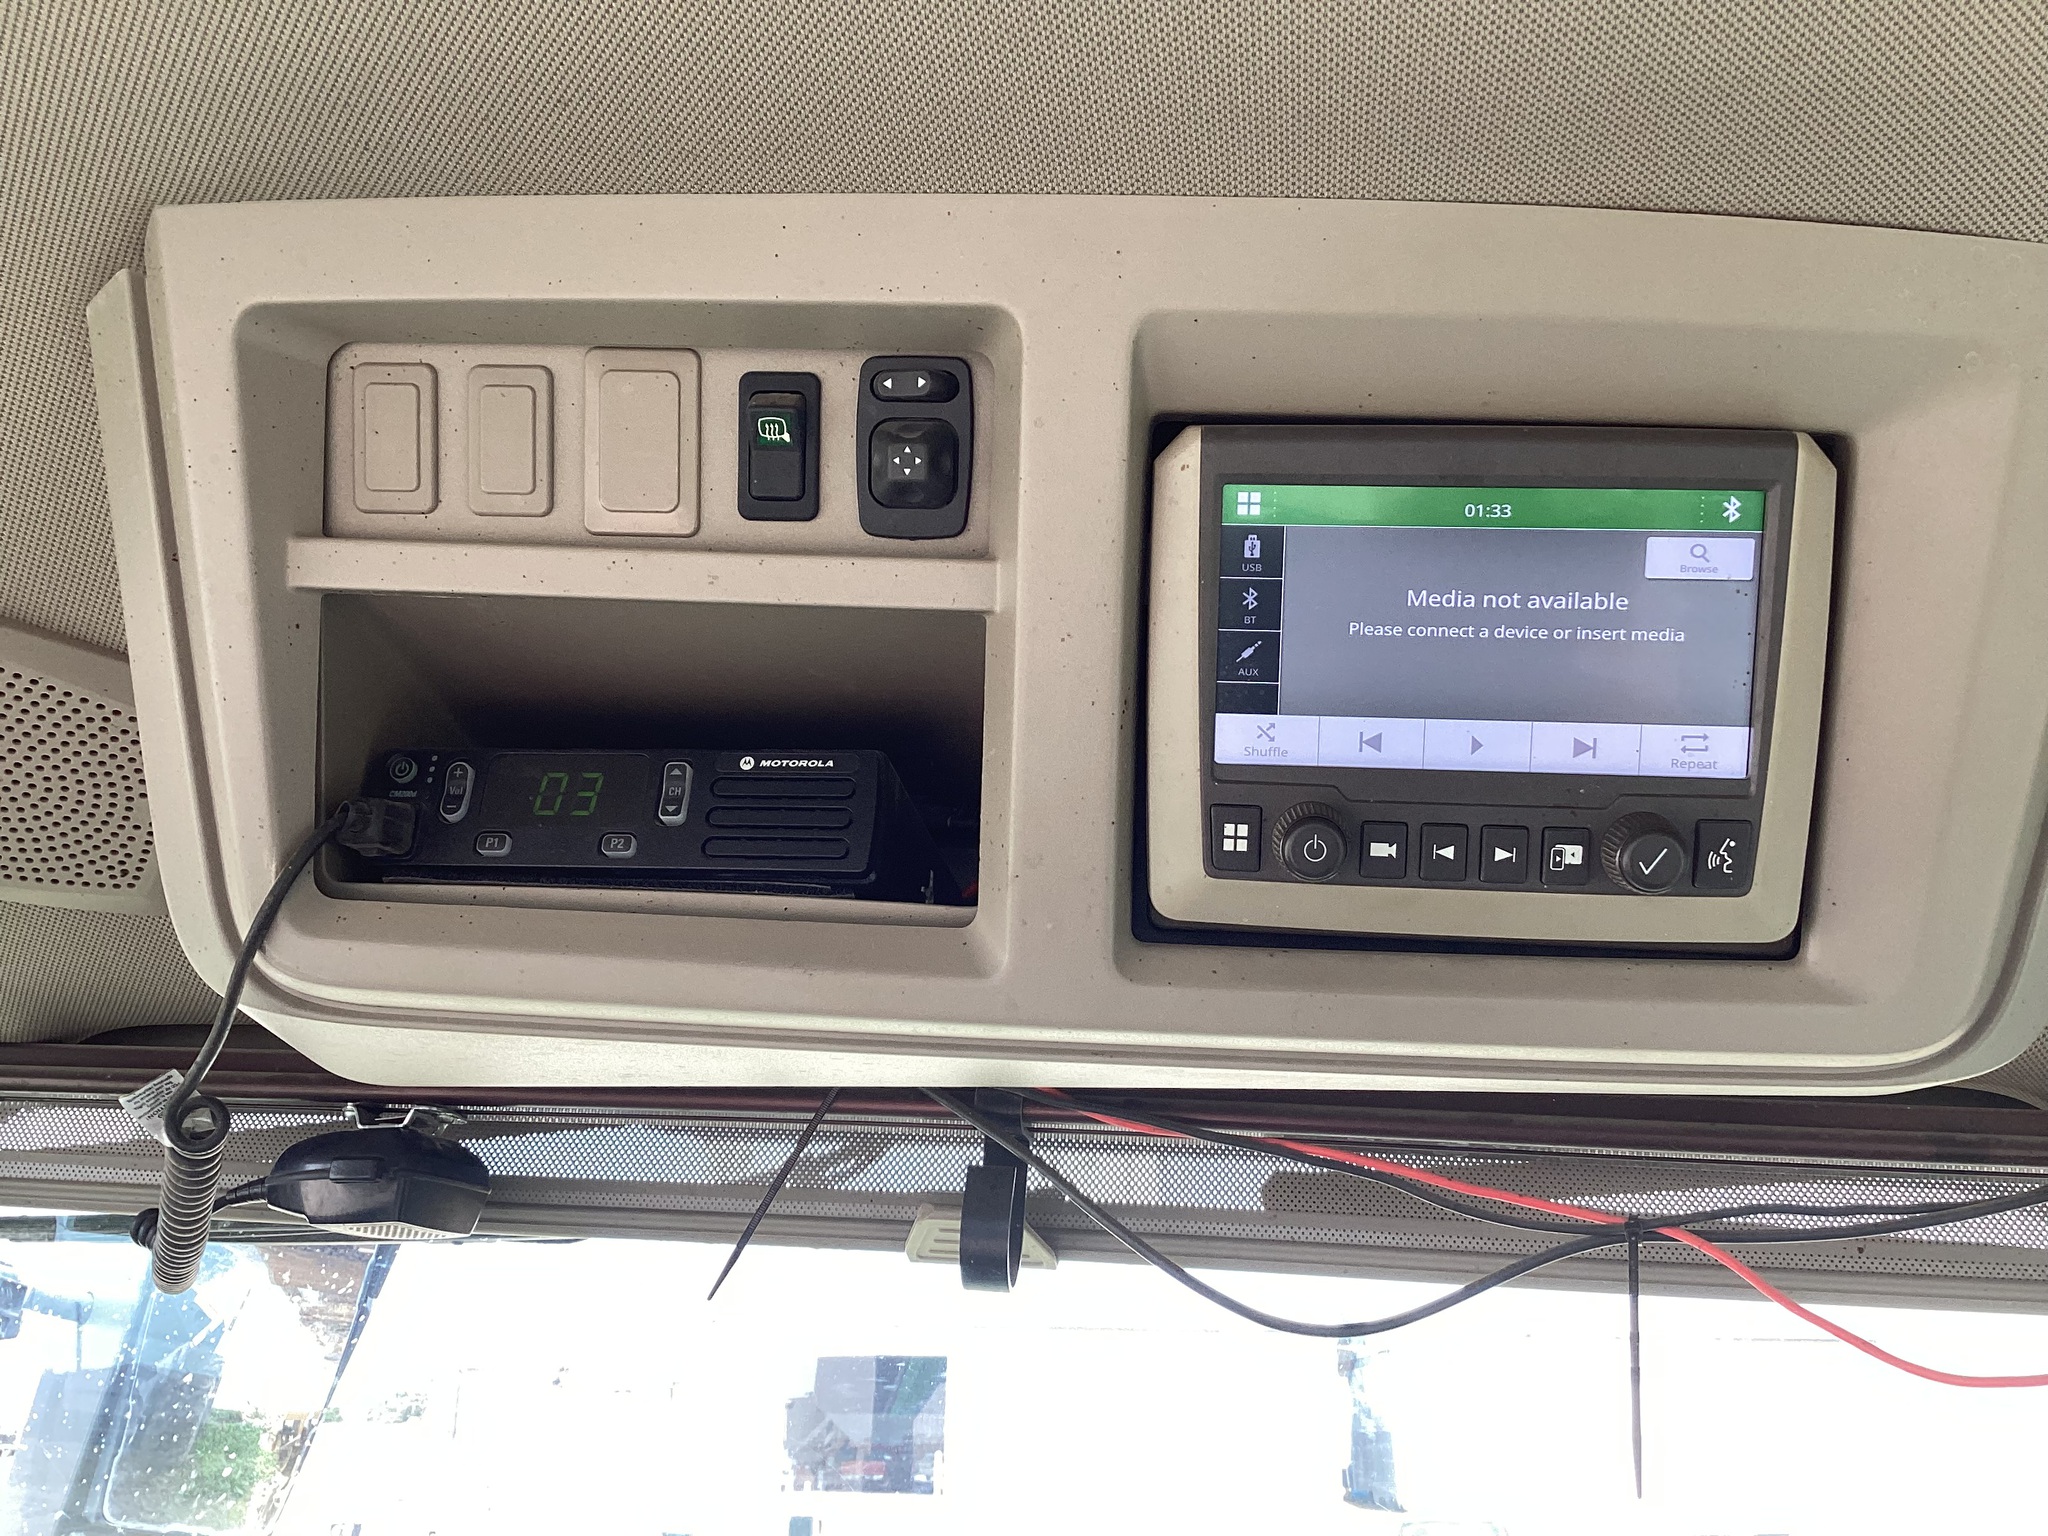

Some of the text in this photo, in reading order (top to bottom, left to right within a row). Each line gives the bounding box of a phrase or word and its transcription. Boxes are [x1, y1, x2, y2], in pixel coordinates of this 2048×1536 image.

[1464, 504, 1512, 518] 01:33
[1241, 563, 1262, 572] USB
[1679, 564, 1719, 574] Browse
[1406, 589, 1629, 611] Media not available
[1243, 616, 1257, 624] BT
[1348, 622, 1685, 642] Please connect a device or insert media
[1238, 667, 1259, 677] AUX
[1243, 745, 1289, 758] Shuffle
[759, 759, 834, 768] MOTOROLA
[1670, 757, 1718, 772] Repeat
[449, 786, 464, 795] Vol
[533, 772, 604, 816] 03
[668, 786, 682, 796] CH
[485, 837, 500, 848] P1
[609, 838, 625, 849] P2
